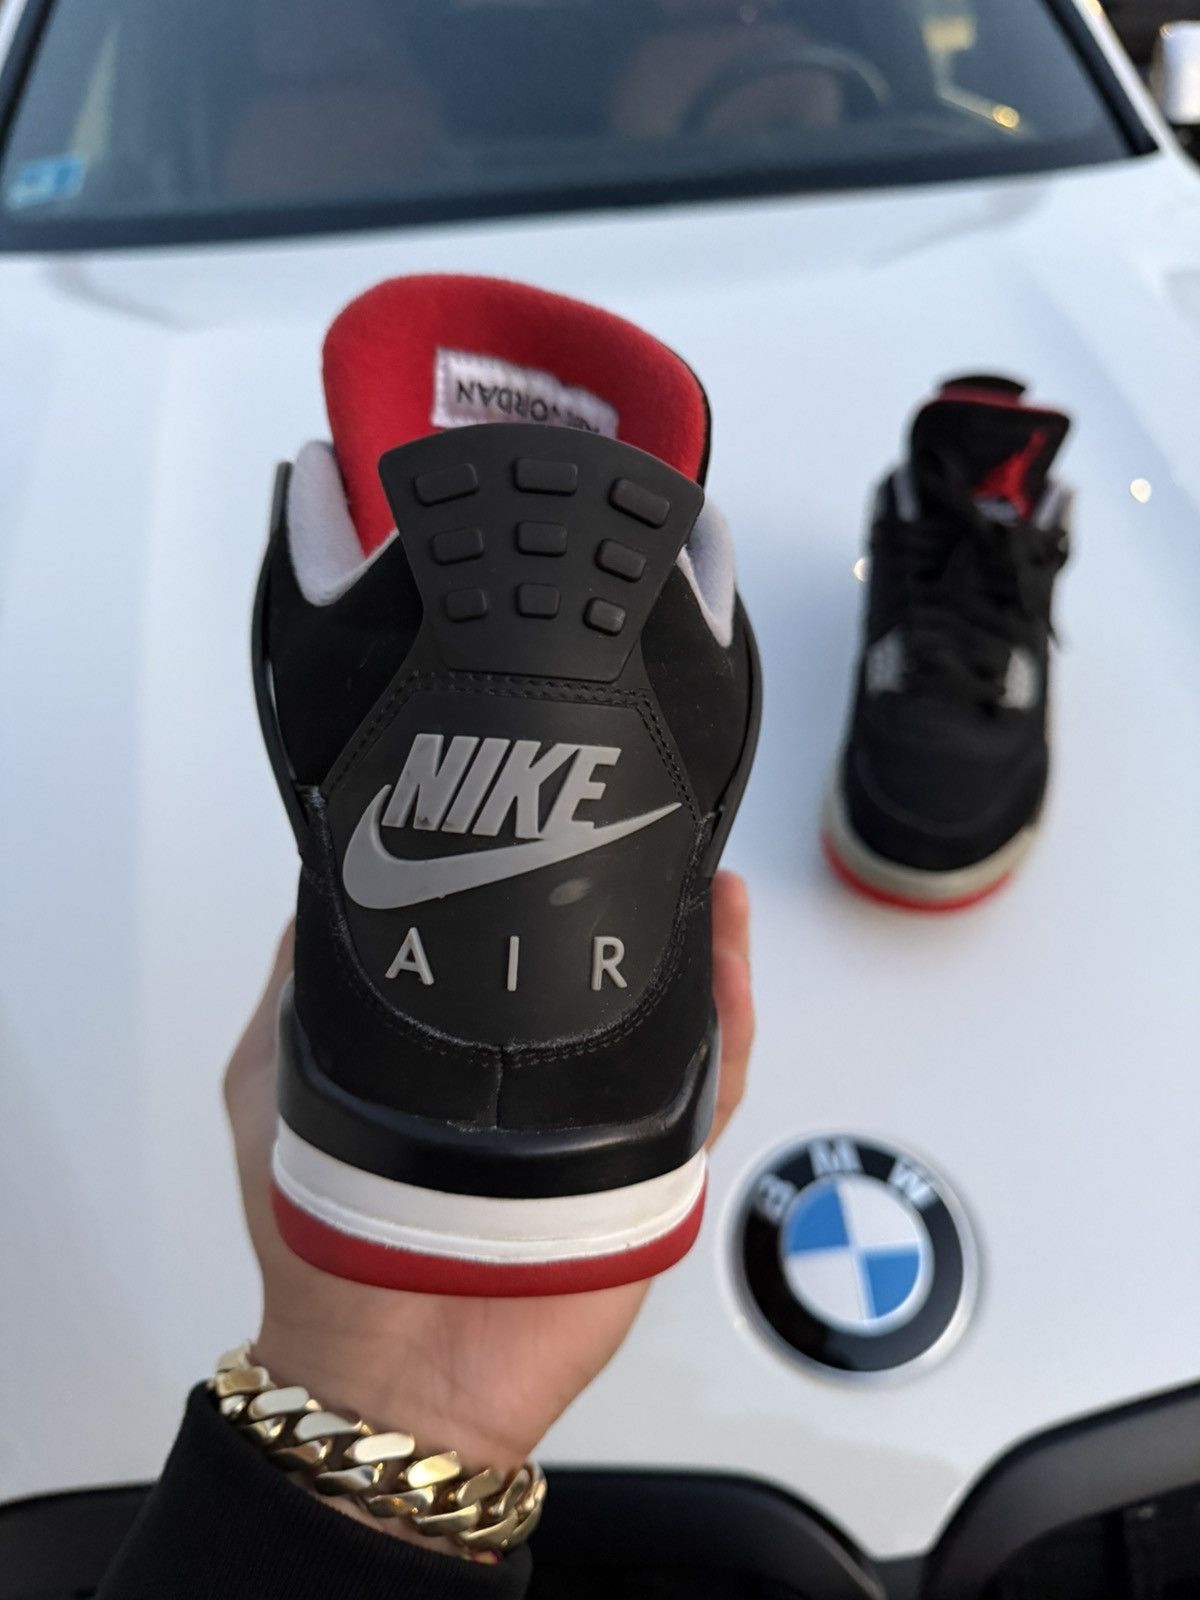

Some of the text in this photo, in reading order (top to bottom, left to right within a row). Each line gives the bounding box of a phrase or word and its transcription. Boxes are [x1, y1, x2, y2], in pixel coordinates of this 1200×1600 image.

[381, 733, 622, 840] NIKE
[384, 926, 628, 992] AIR
[752, 1137, 938, 1225] BMW
